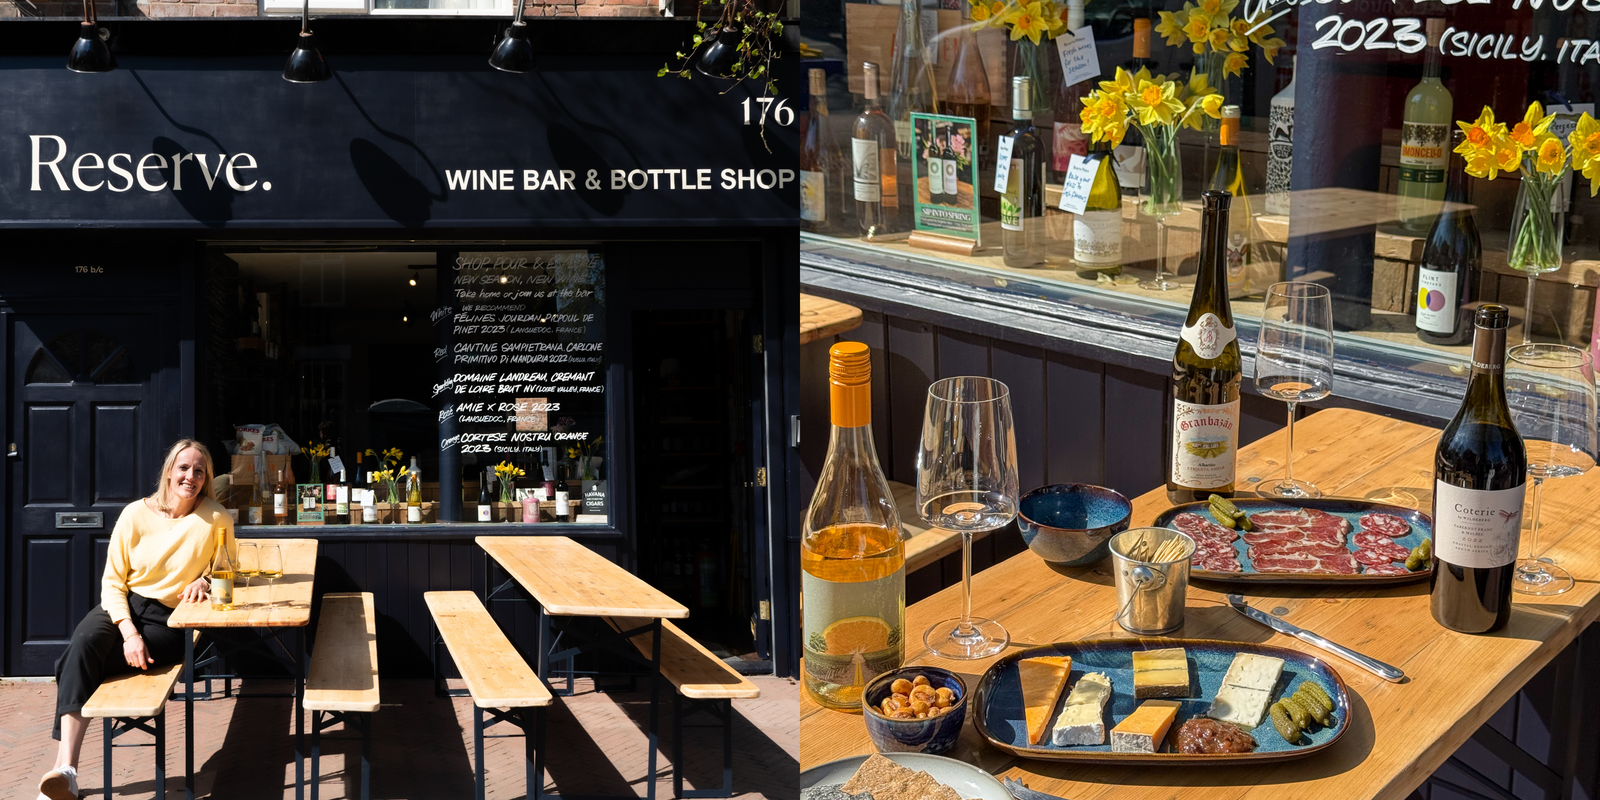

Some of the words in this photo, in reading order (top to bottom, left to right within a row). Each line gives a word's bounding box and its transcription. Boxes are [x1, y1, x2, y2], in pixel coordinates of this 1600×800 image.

[1312, 15, 1427, 54] 2023
[1439, 26, 1547, 62] (SICILY.
[741, 97, 795, 127] 176
[29, 134, 272, 192] Reserve.
[445, 169, 515, 191] WINE
[523, 169, 577, 191] BAR
[585, 169, 602, 190] &
[610, 169, 712, 190] BOTTLE
[720, 168, 796, 190] SHOP
[75, 265, 89, 274] 176
[90, 265, 104, 274] b/c
[493, 256, 528, 271] POUR
[453, 274, 480, 285] NEW
[525, 273, 556, 285] NEW
[454, 288, 477, 298] Take
[478, 288, 502, 299] home
[510, 289, 532, 300] join
[546, 288, 558, 298] at
[559, 288, 574, 298] the
[575, 287, 594, 298] bar
[461, 304, 474, 312] WE
[474, 304, 527, 312] RECOMMEND
[582, 313, 595, 323] DE
[452, 325, 480, 335] PINET
[480, 325, 506, 335] 2023
[453, 343, 499, 353] CANTINE
[453, 354, 498, 364] PRIMITIVO
[509, 354, 549, 364] MANDURIA
[548, 354, 568, 364] 2022
[453, 372, 498, 383] DOMAINE
[550, 371, 596, 383] CREMANT
[454, 384, 468, 395] DE
[468, 384, 496, 394] LOIRE
[497, 383, 523, 394] BRUT
[523, 383, 537, 393] NV
[455, 402, 485, 413] AMIE
[531, 402, 561, 412] 2023
[1180, 415, 1234, 431] Granbazán
[460, 432, 508, 443] CORTESE
[510, 432, 552, 443] NOSTRU
[553, 432, 589, 441] ORANGE
[460, 443, 492, 454] 2023
[521, 444, 543, 453] ITALY)
[1454, 503, 1496, 516] Coterie
